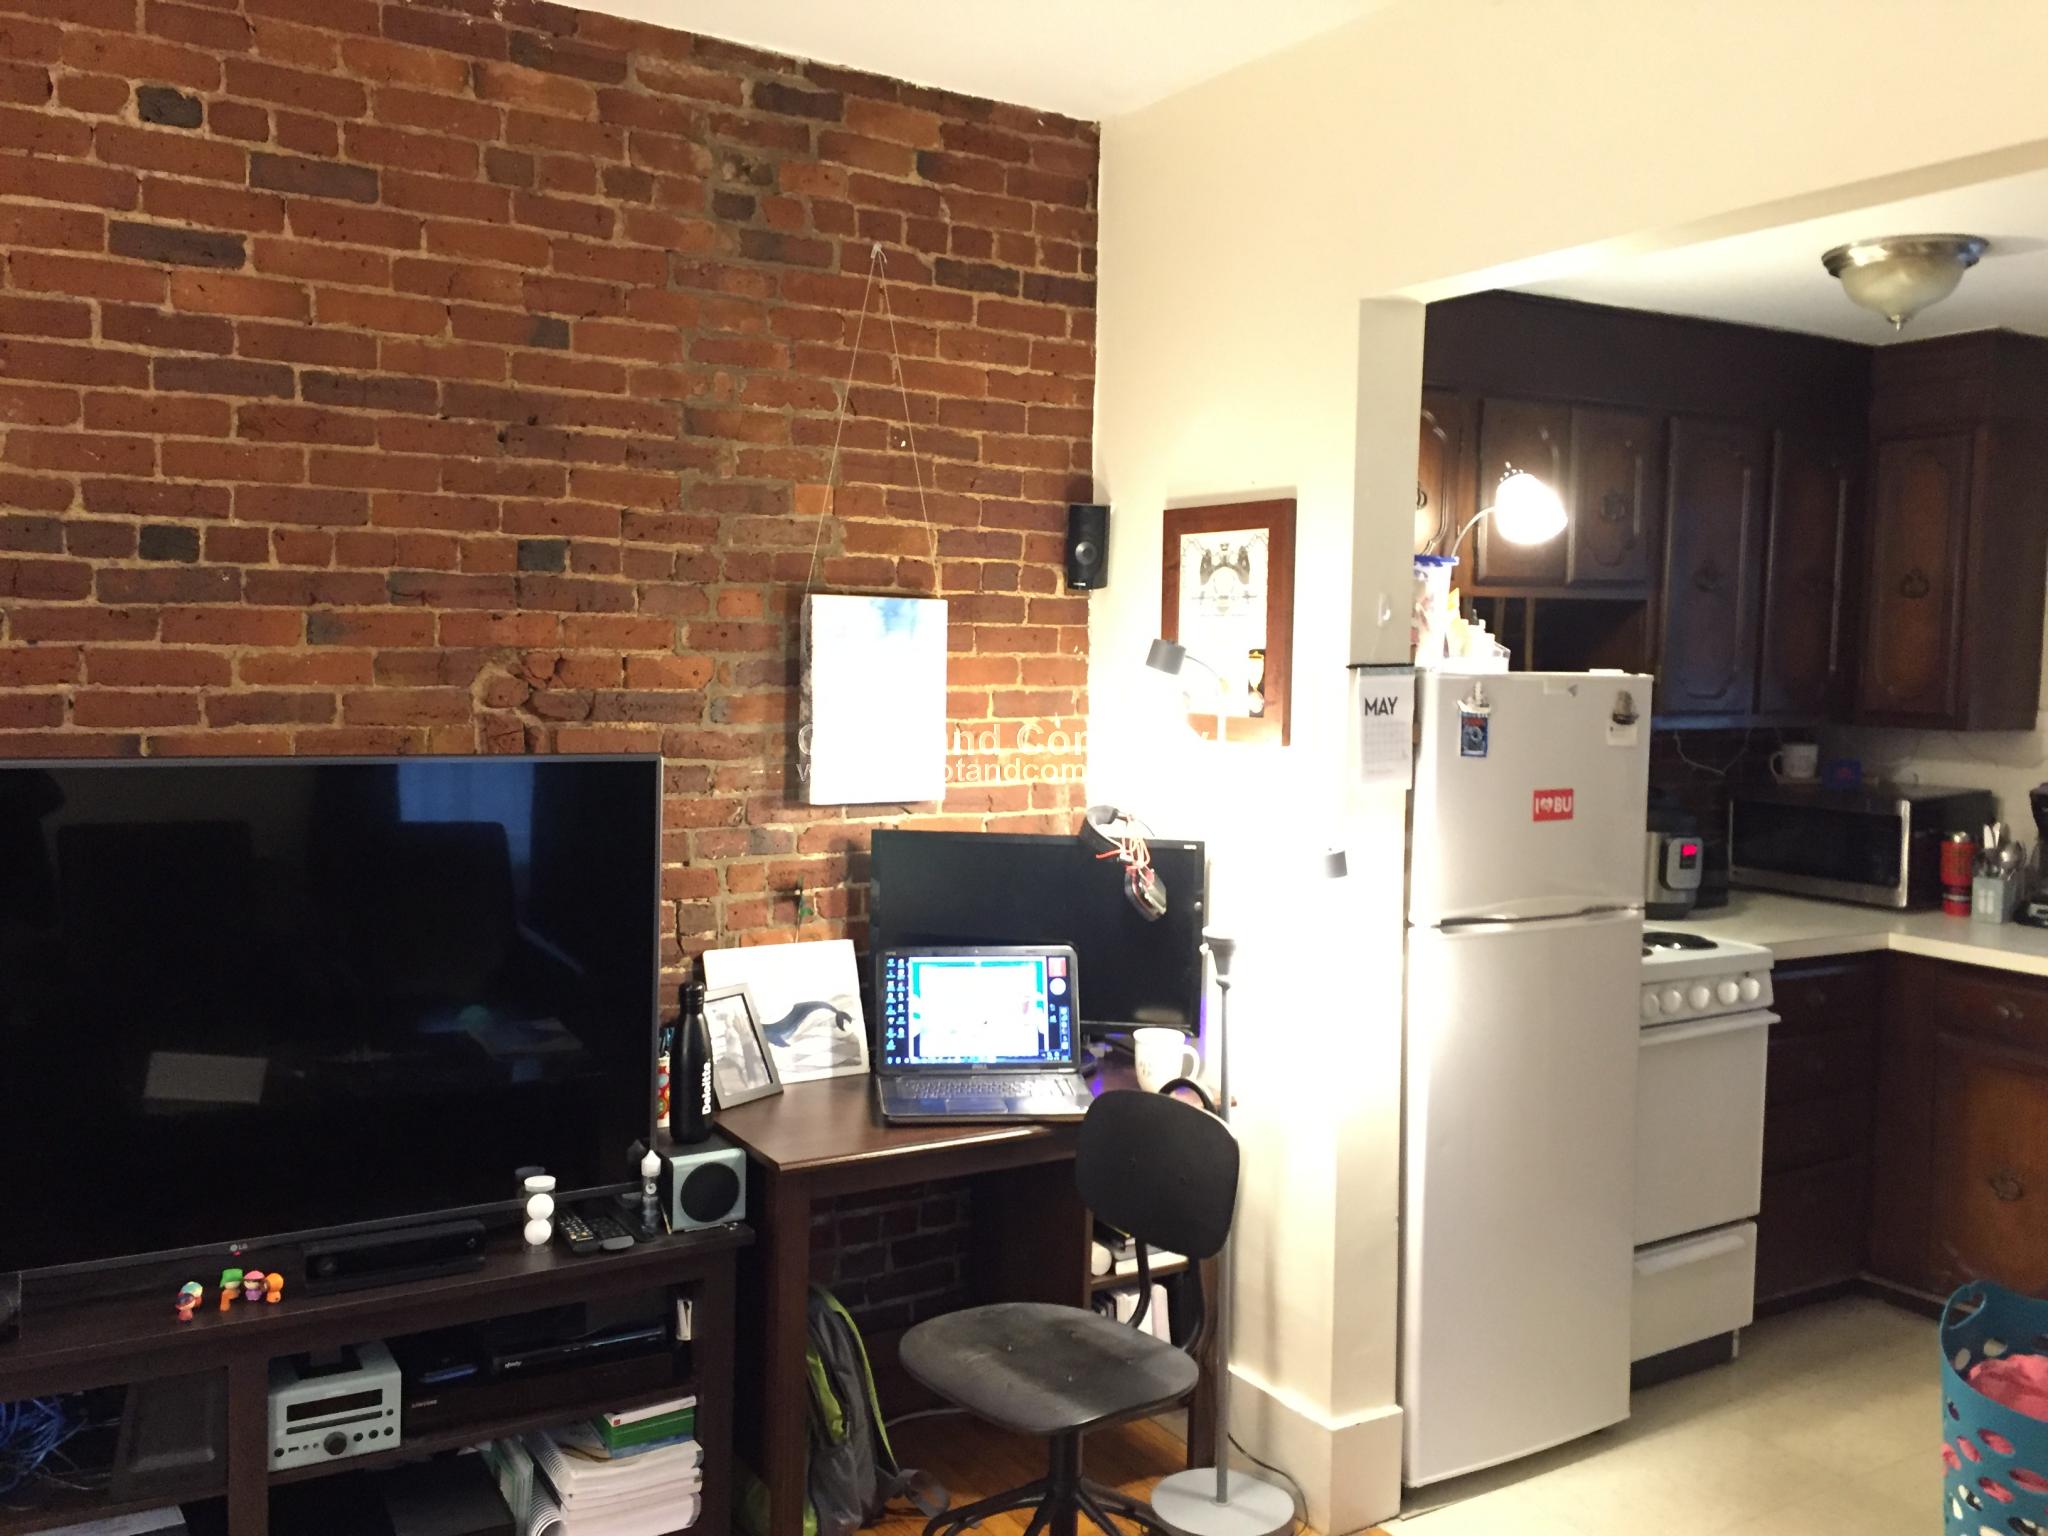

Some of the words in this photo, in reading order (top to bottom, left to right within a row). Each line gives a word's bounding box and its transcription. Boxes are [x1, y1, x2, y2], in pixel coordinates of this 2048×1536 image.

[1364, 696, 1398, 716] MAY
[1535, 797, 1540, 815] I
[1553, 796, 1572, 814] BU
